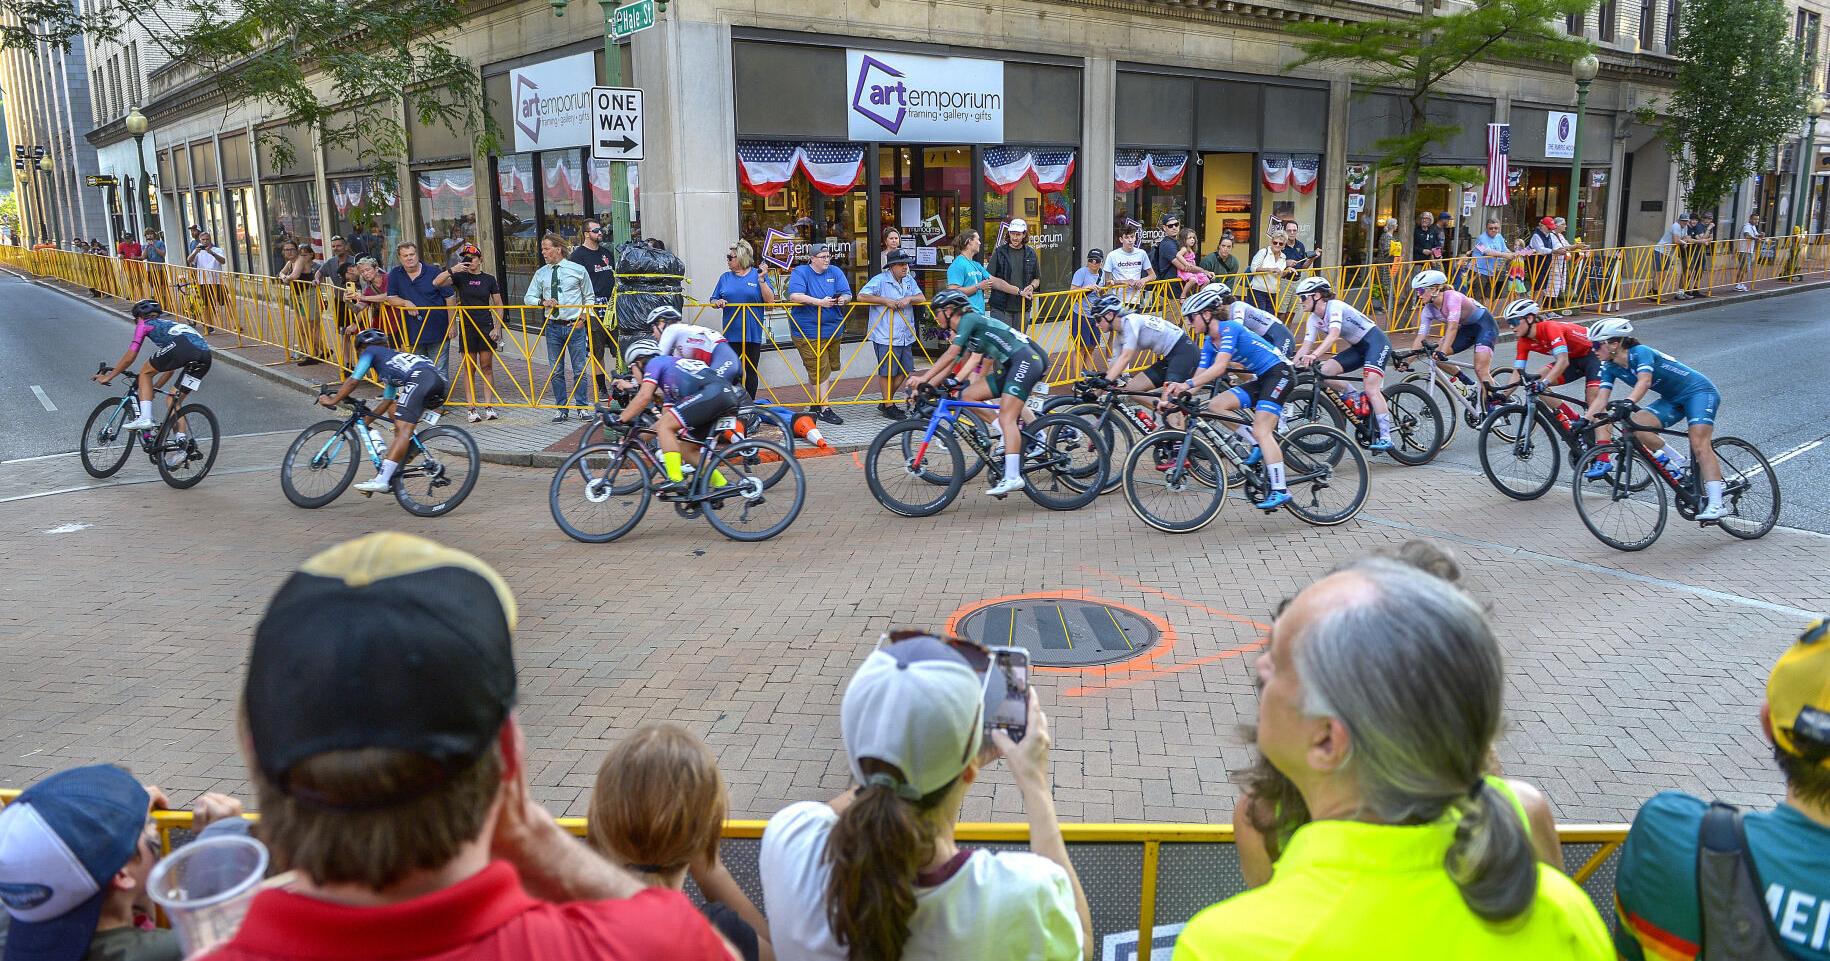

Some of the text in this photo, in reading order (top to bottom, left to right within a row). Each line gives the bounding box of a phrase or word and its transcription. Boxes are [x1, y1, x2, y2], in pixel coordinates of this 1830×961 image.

[623, 3, 652, 32] Hale St
[598, 93, 637, 111] ONE
[869, 80, 1001, 111] art emporium
[522, 92, 540, 118] art
[560, 113, 576, 126] gallery
[599, 114, 638, 132] WAY
[908, 107, 992, 123] framing gallery gifts
[772, 239, 795, 256] art
[187, 378, 195, 387] 7
[1027, 399, 1040, 410] 20
[1326, 386, 1362, 425] VENTUM
[719, 419, 732, 429] 22
[1196, 416, 1244, 466] TREK
